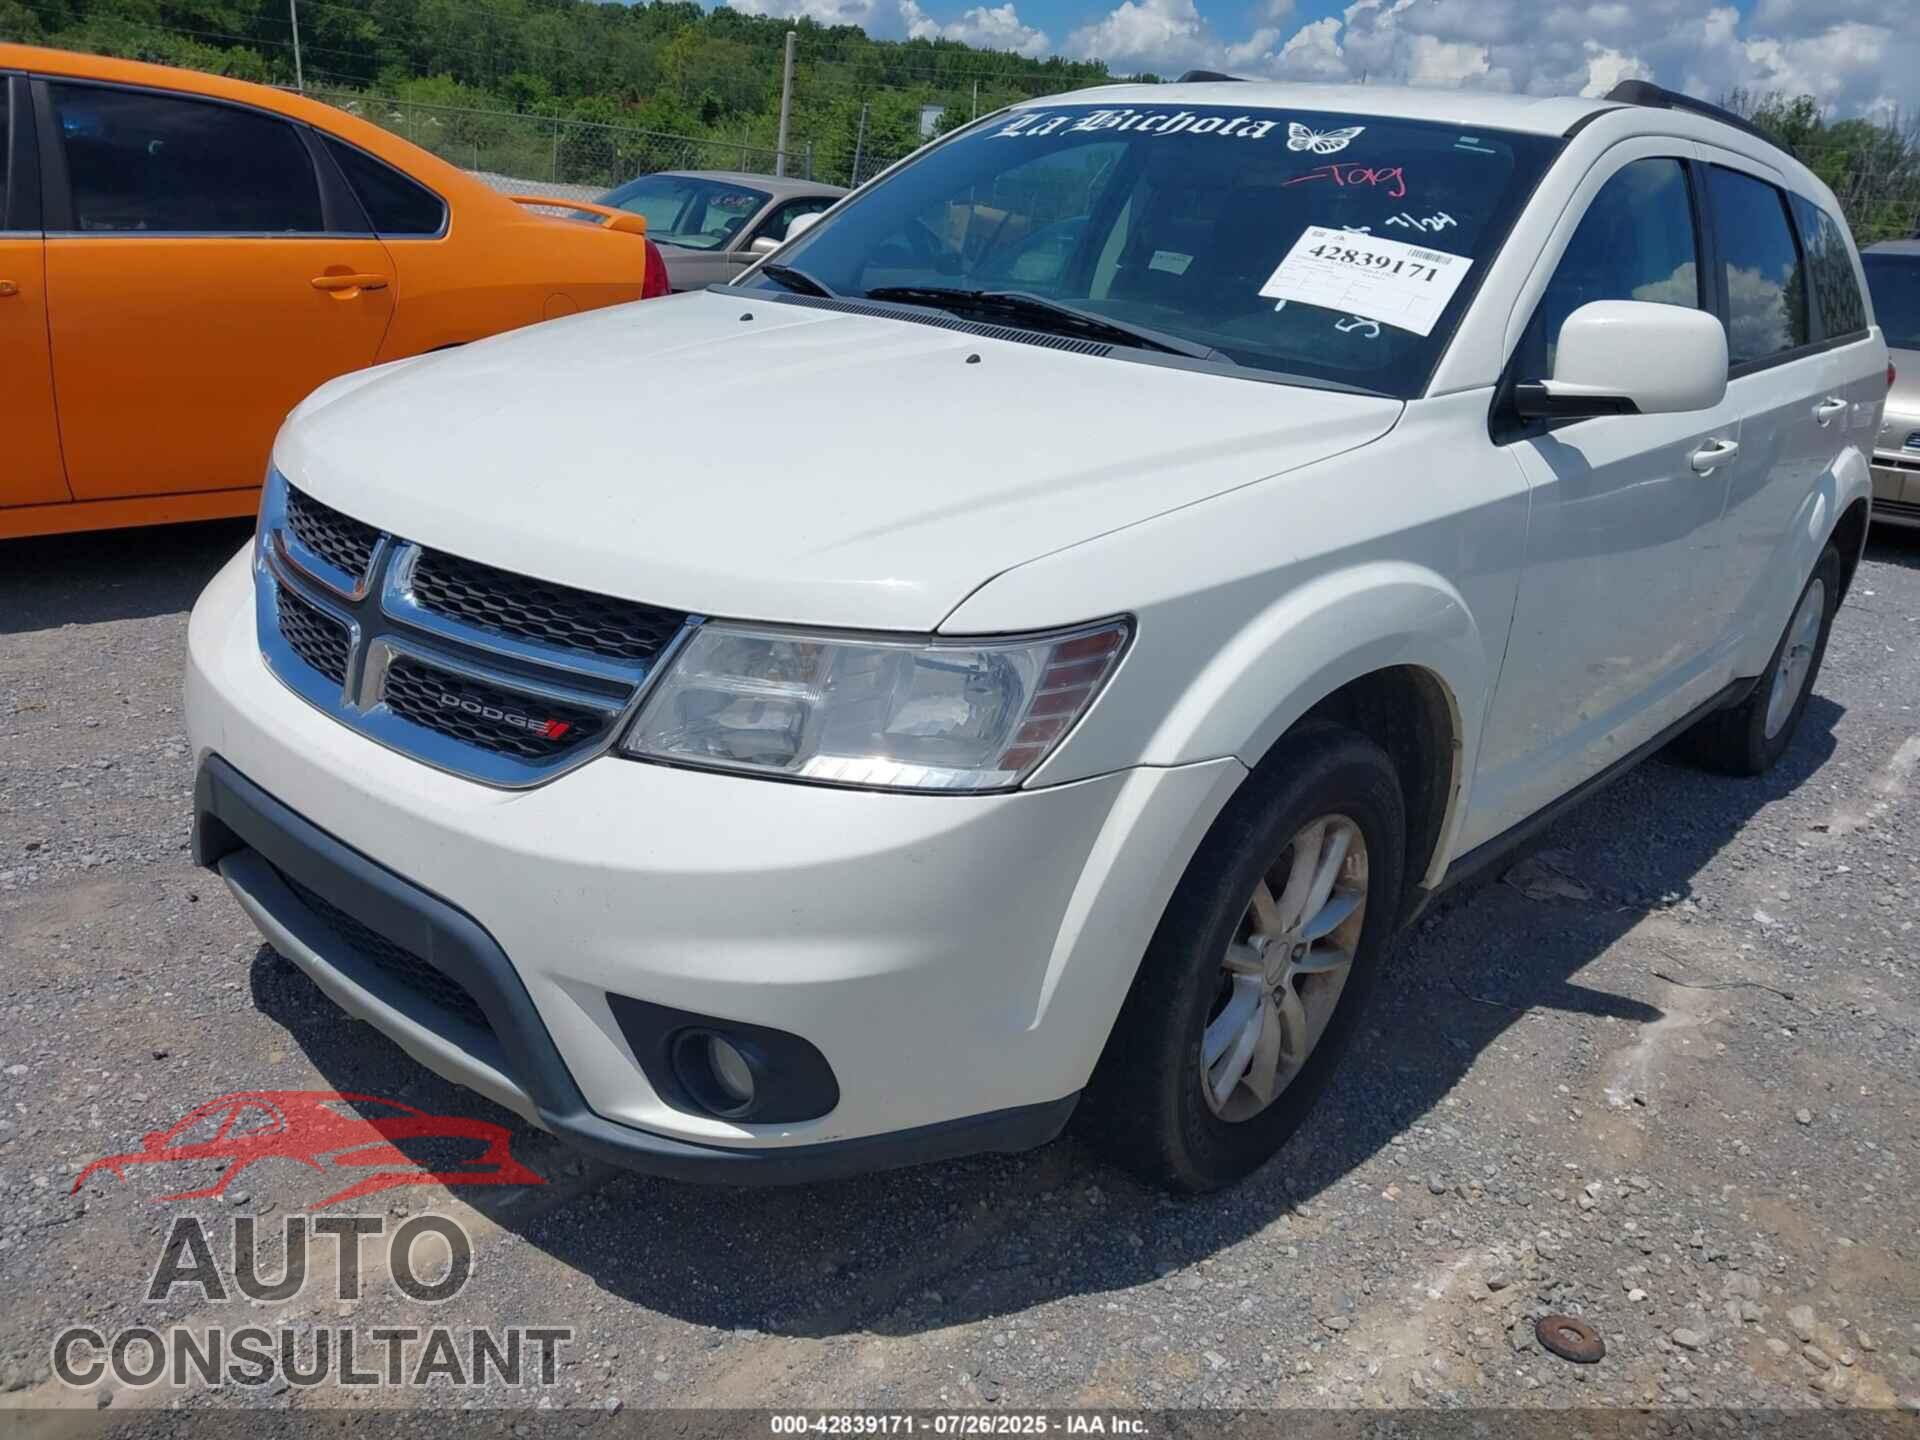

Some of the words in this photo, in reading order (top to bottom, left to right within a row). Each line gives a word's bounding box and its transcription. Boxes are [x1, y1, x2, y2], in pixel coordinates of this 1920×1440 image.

[985, 112, 1075, 138] La
[1060, 109, 1280, 139] Bichota
[1309, 244, 1438, 282] 42839171
[441, 693, 548, 732] DODGE
